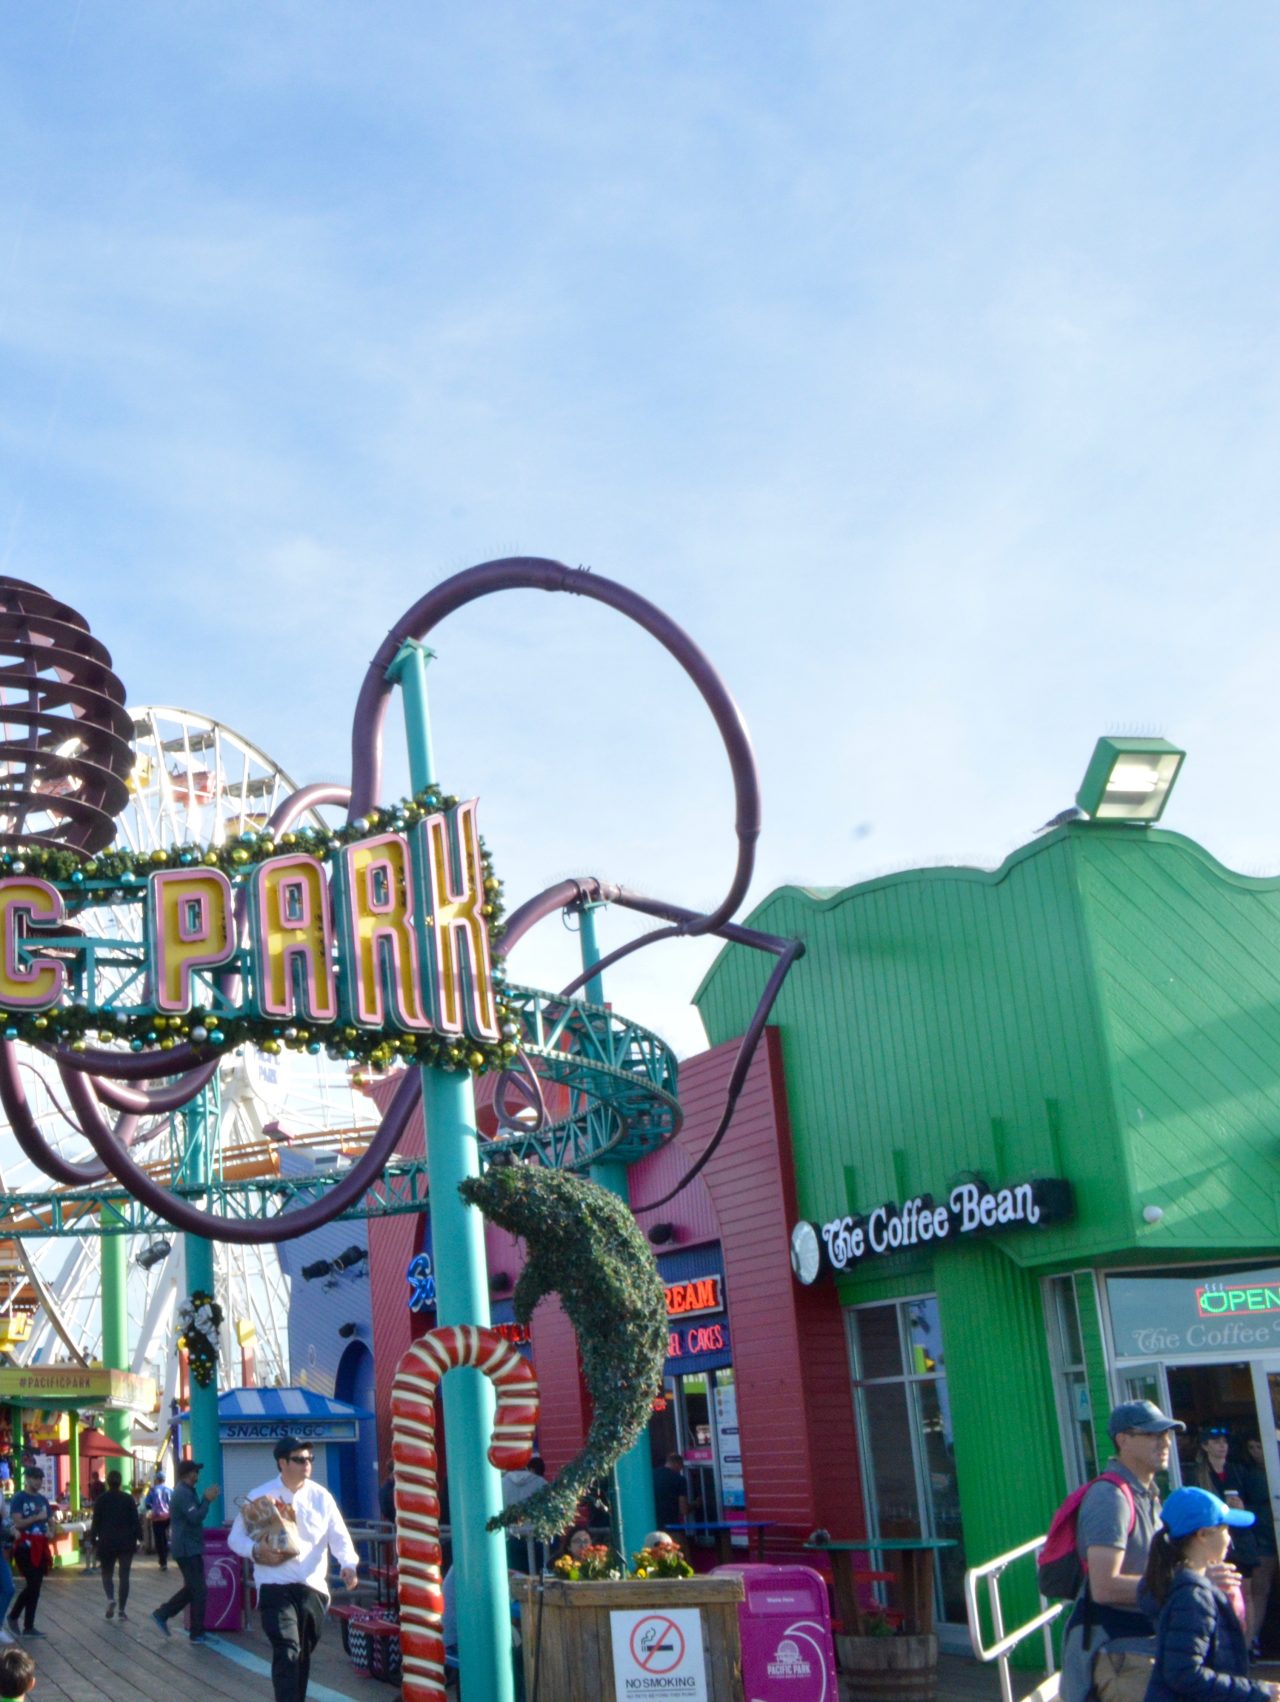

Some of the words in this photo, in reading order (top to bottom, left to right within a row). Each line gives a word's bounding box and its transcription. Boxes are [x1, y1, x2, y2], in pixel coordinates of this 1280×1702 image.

[148, 796, 501, 1043] PARK
[822, 1216, 865, 1269] The
[868, 1197, 950, 1253] Coffee
[950, 1183, 1040, 1232] Bean
[663, 1279, 716, 1315] REAM
[1200, 1288, 1280, 1313] OPEN
[688, 1325, 724, 1354] CAKES
[1132, 1327, 1181, 1354] The
[1186, 1322, 1270, 1348] Coffee
[19, 1376, 91, 1389] #PACIFICPARK
[227, 1424, 288, 1437] SNACKS
[625, 1678, 641, 1688] NO
[642, 1675, 696, 1688] SMOKING
[767, 1663, 793, 1675] PACIFIC
[793, 1662, 812, 1674] PARK
